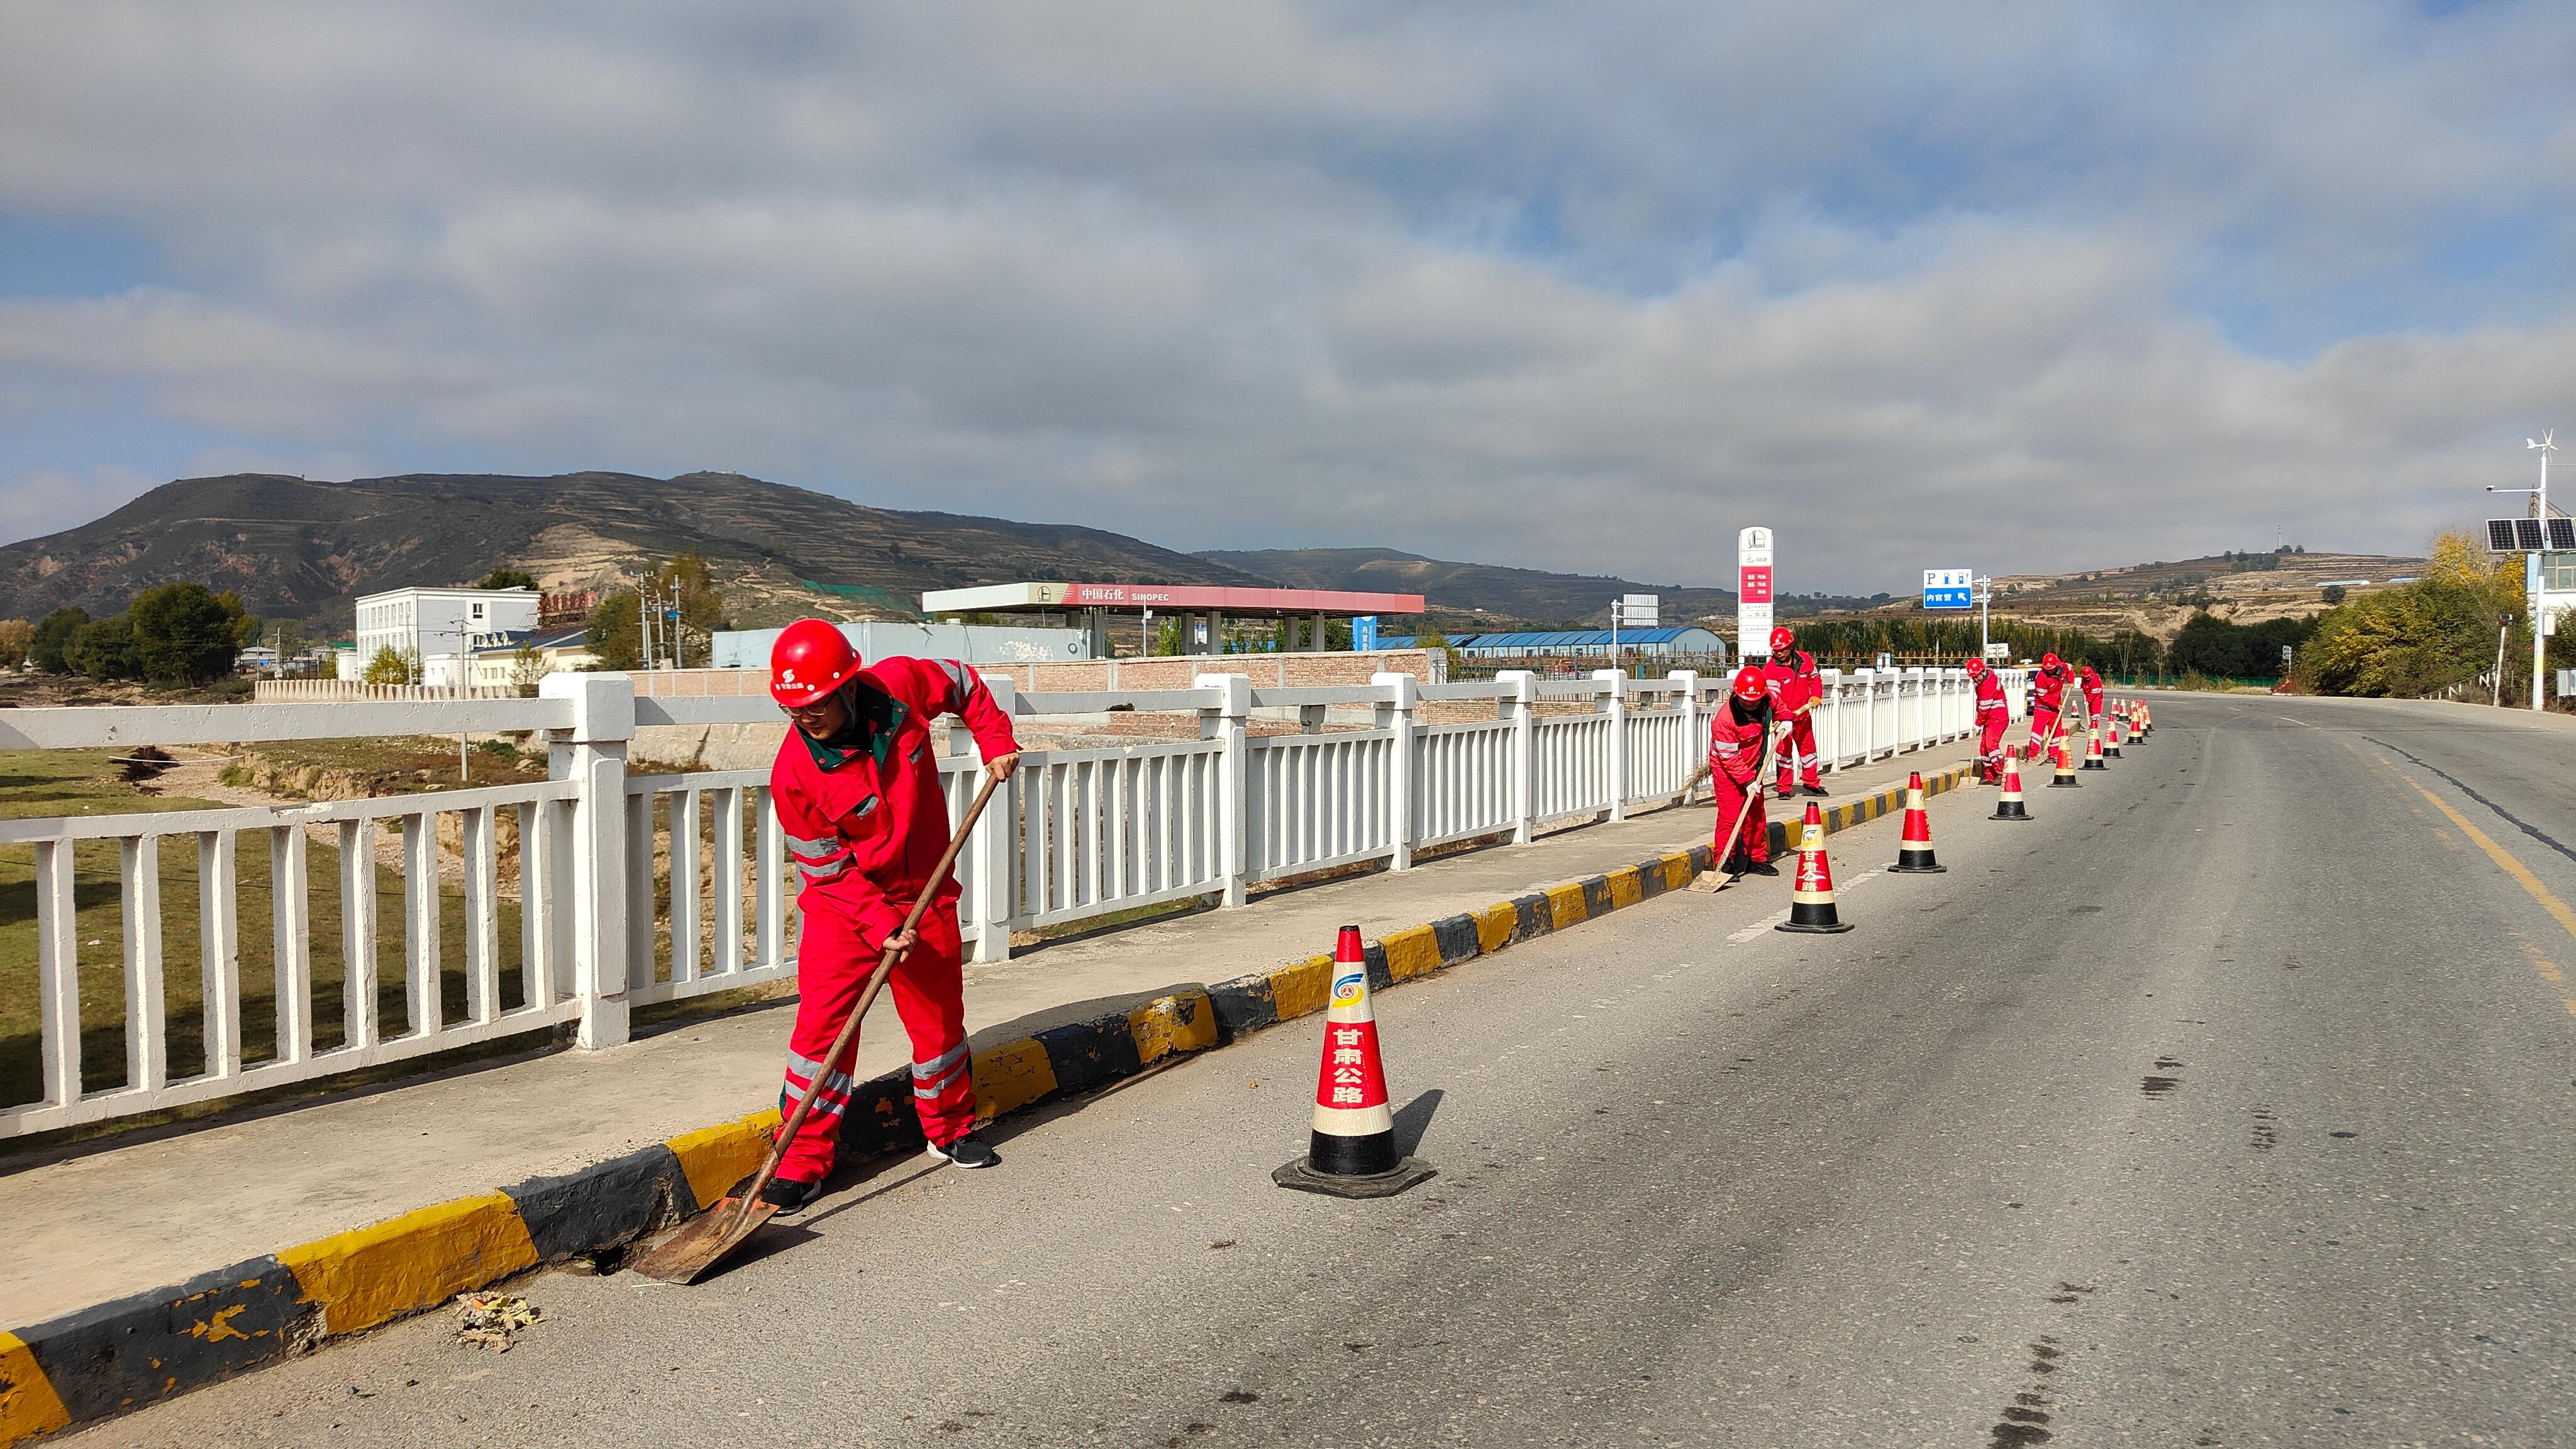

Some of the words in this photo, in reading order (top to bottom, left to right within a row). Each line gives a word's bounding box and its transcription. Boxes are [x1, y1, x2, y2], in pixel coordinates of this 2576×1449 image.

[1082, 588, 1124, 601] 中国石化
[1131, 593, 1169, 601] SINOPEC
[1926, 593, 1952, 602] 内官营
[1799, 851, 1823, 892] 甘肃公路
[1333, 1028, 1363, 1104] 甘肃公路
